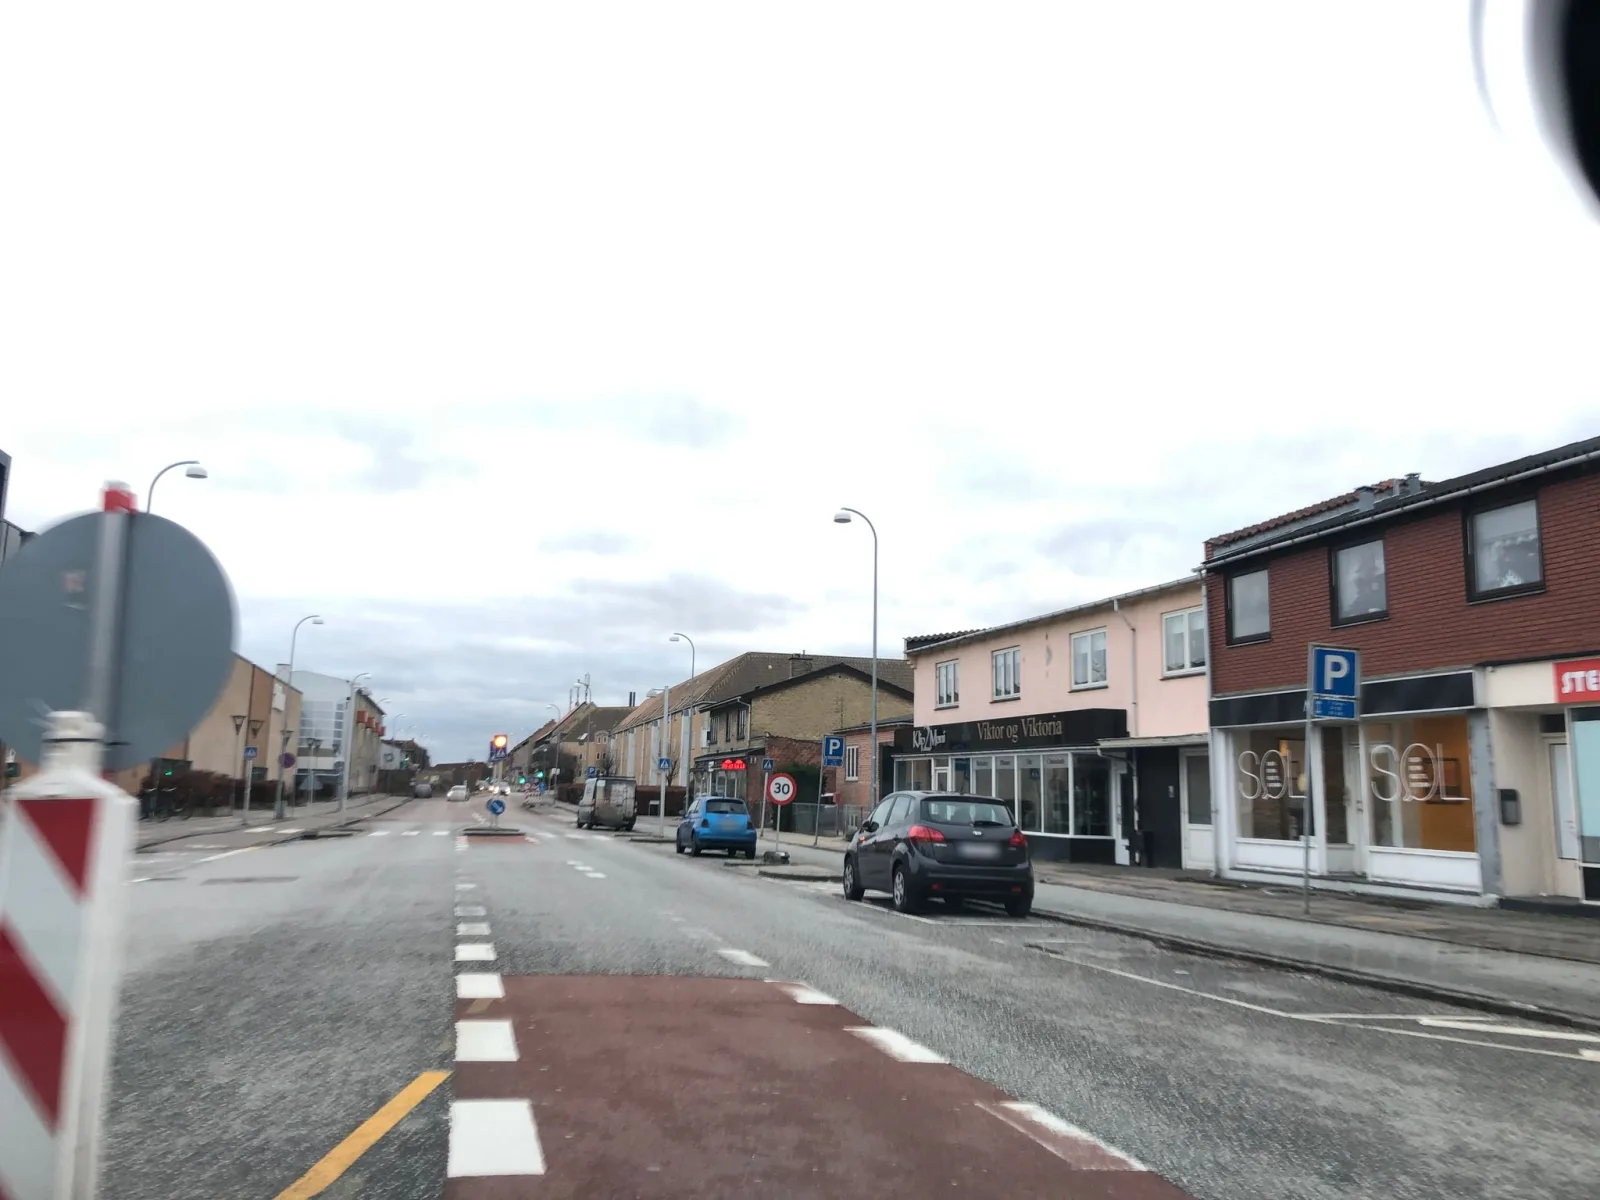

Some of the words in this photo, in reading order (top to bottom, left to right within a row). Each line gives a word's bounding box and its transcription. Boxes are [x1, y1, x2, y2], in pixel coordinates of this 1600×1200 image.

[1324, 654, 1350, 690] P
[977, 722, 1004, 741] Viktor
[1006, 724, 1018, 743] og
[1021, 716, 1062, 737] Viktoria
[829, 739, 840, 755] P
[1238, 749, 1307, 800] SOL
[1371, 743, 1470, 802] SOL
[773, 782, 790, 795] 30
